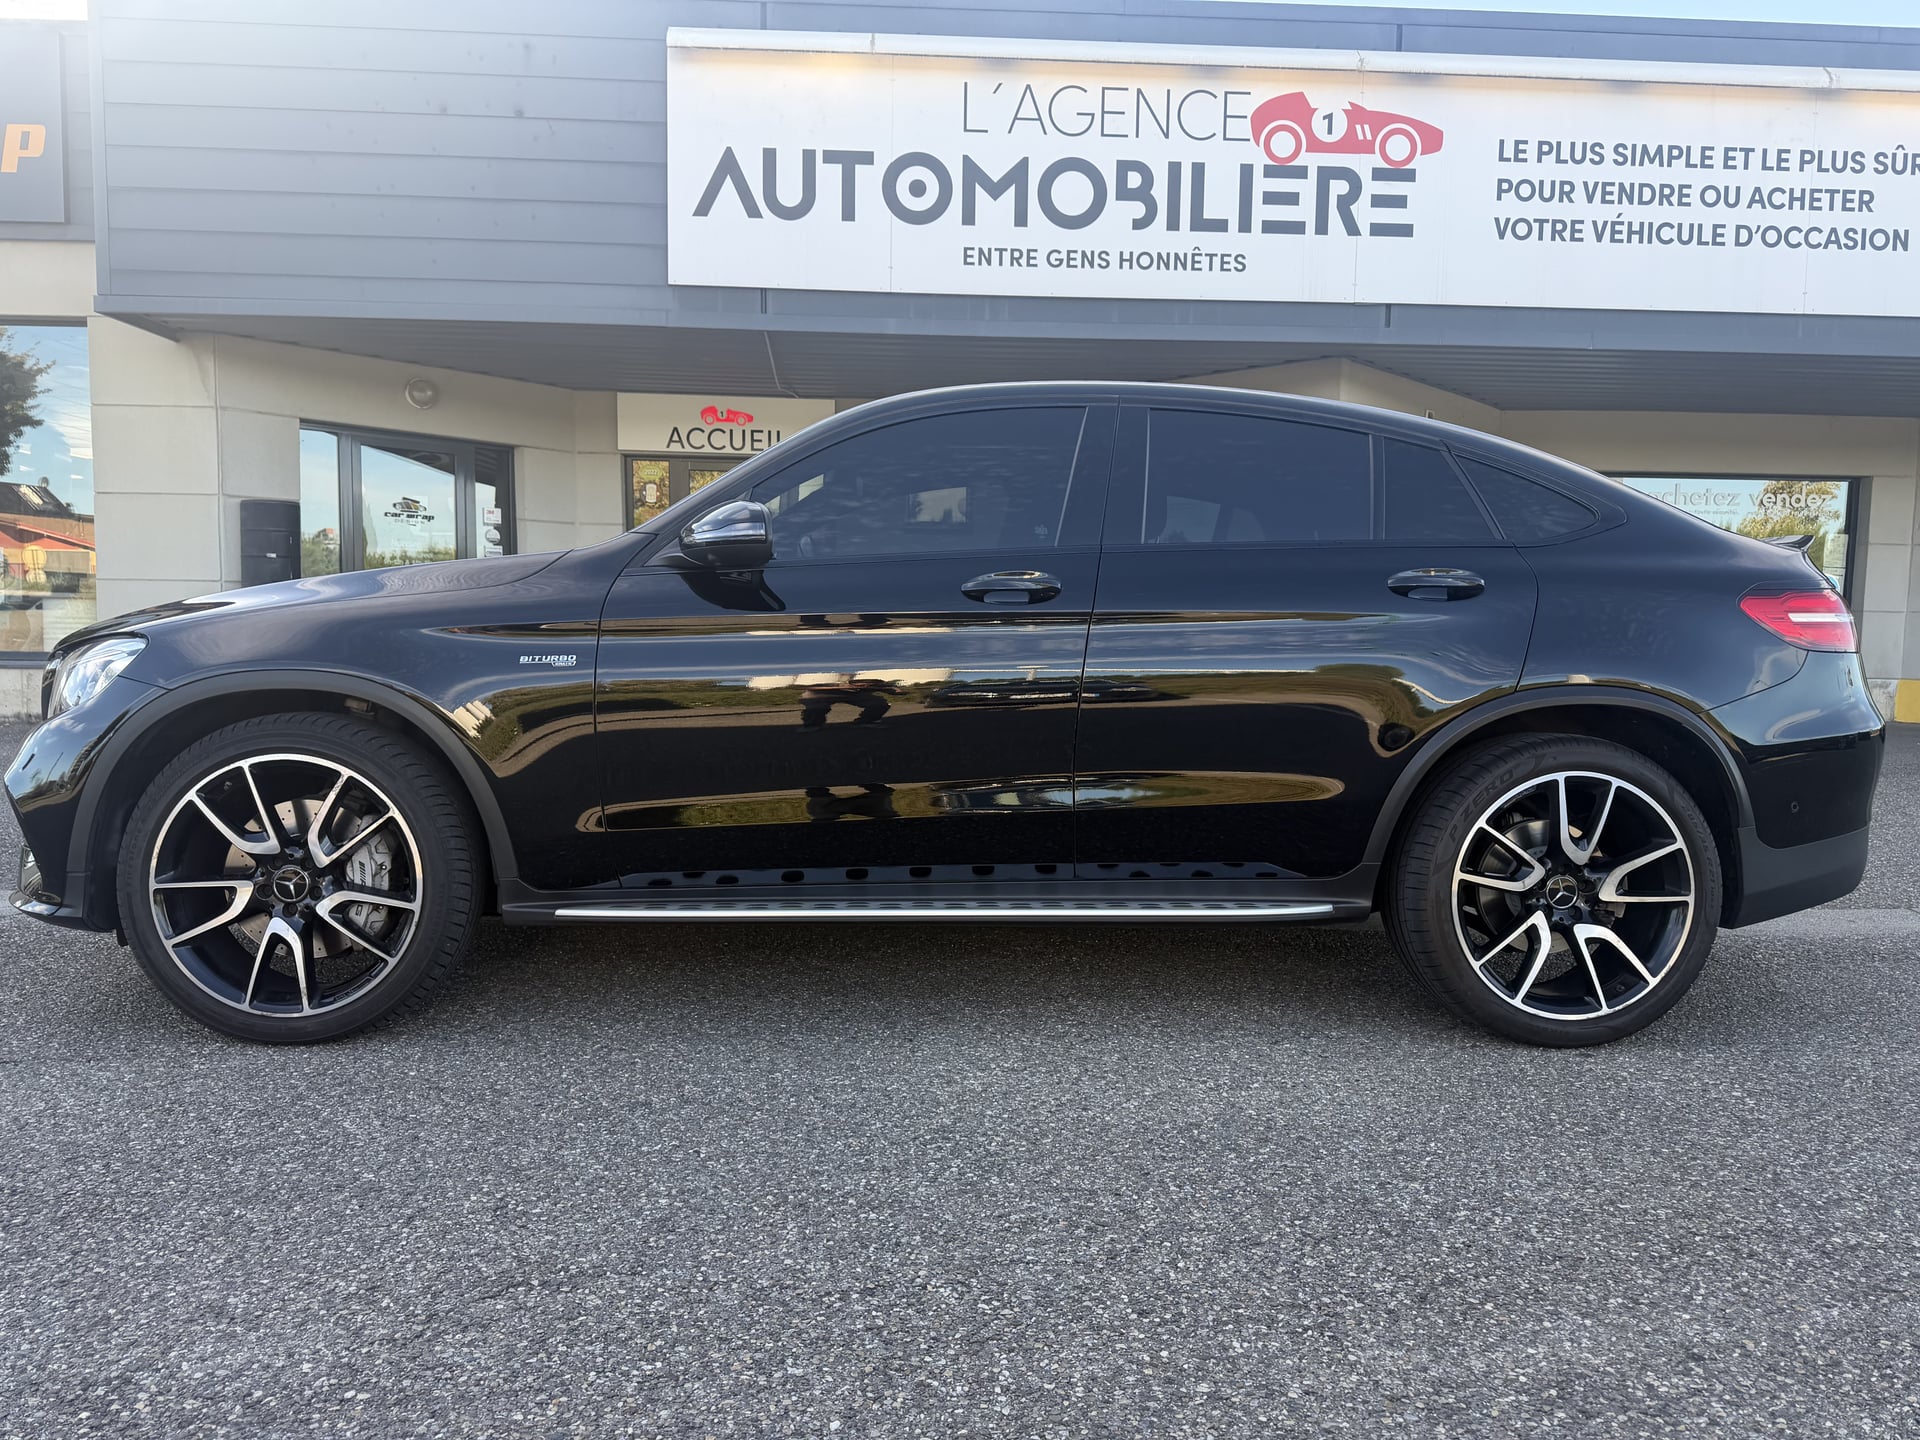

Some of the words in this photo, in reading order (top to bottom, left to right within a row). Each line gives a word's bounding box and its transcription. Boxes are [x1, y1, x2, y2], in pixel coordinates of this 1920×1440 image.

[1498, 139, 1529, 163] LE
[1536, 140, 1605, 166] PLUS
[1612, 143, 1715, 169] SIMPLE
[1722, 146, 1755, 171] ET
[1761, 148, 1791, 171] LE
[1799, 149, 1866, 175] PLUS
[1496, 178, 1575, 204] POUR
[1583, 181, 1692, 207] VENDRE
[1700, 185, 1741, 209] OU
[1746, 187, 1875, 213] ACHETER
[1494, 217, 1584, 243] VOTRE
[1592, 213, 1726, 247] VÉHICULE
[1734, 224, 1909, 252] D'OCCASION
[963, 247, 1038, 268] ENTRE
[1045, 249, 1111, 270] GENS
[1119, 247, 1247, 273] HONNÊTES
[1749, 483, 1832, 508] vendez
